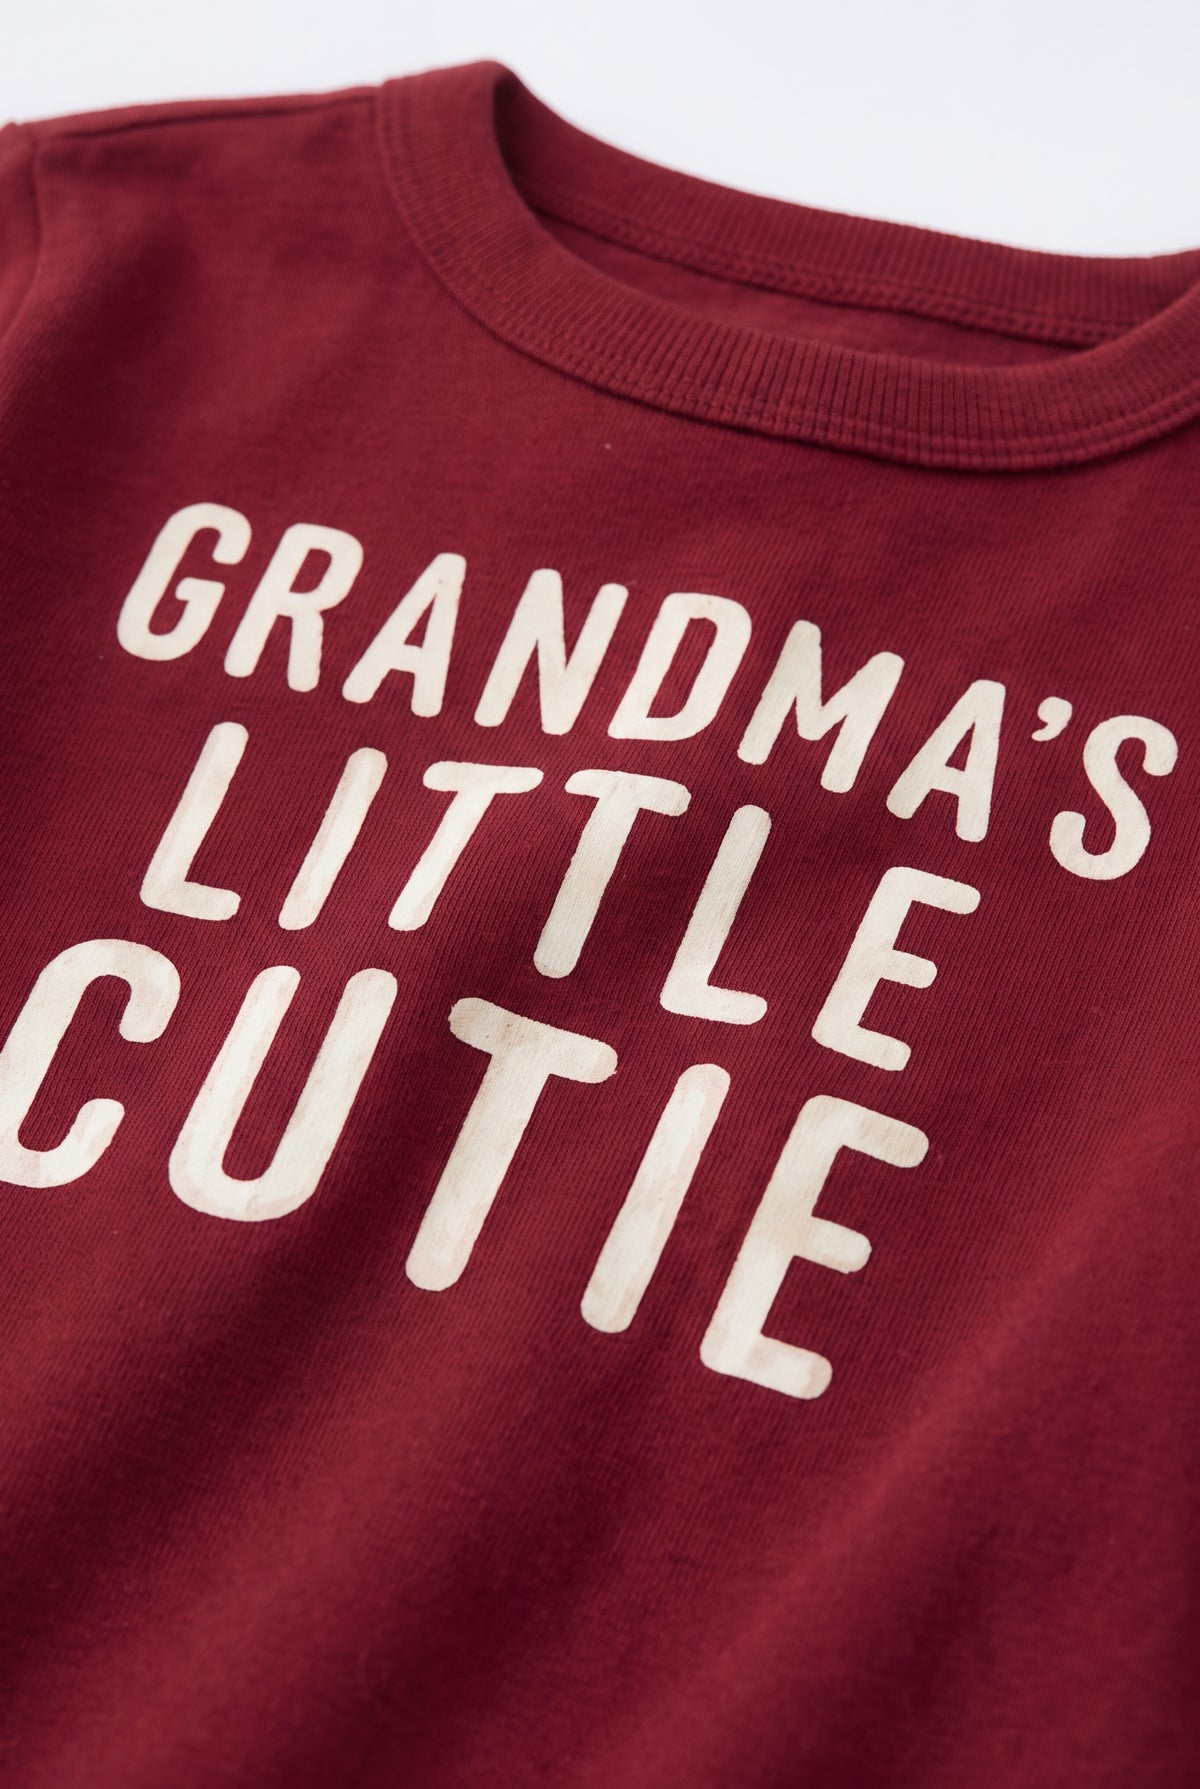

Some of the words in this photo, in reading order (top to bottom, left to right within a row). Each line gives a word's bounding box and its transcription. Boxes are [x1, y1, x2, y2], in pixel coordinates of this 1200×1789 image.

[117, 502, 1179, 881] GRANDMA’S
[139, 721, 981, 1072] LITTLE
[0, 938, 929, 1400] CUTIE
